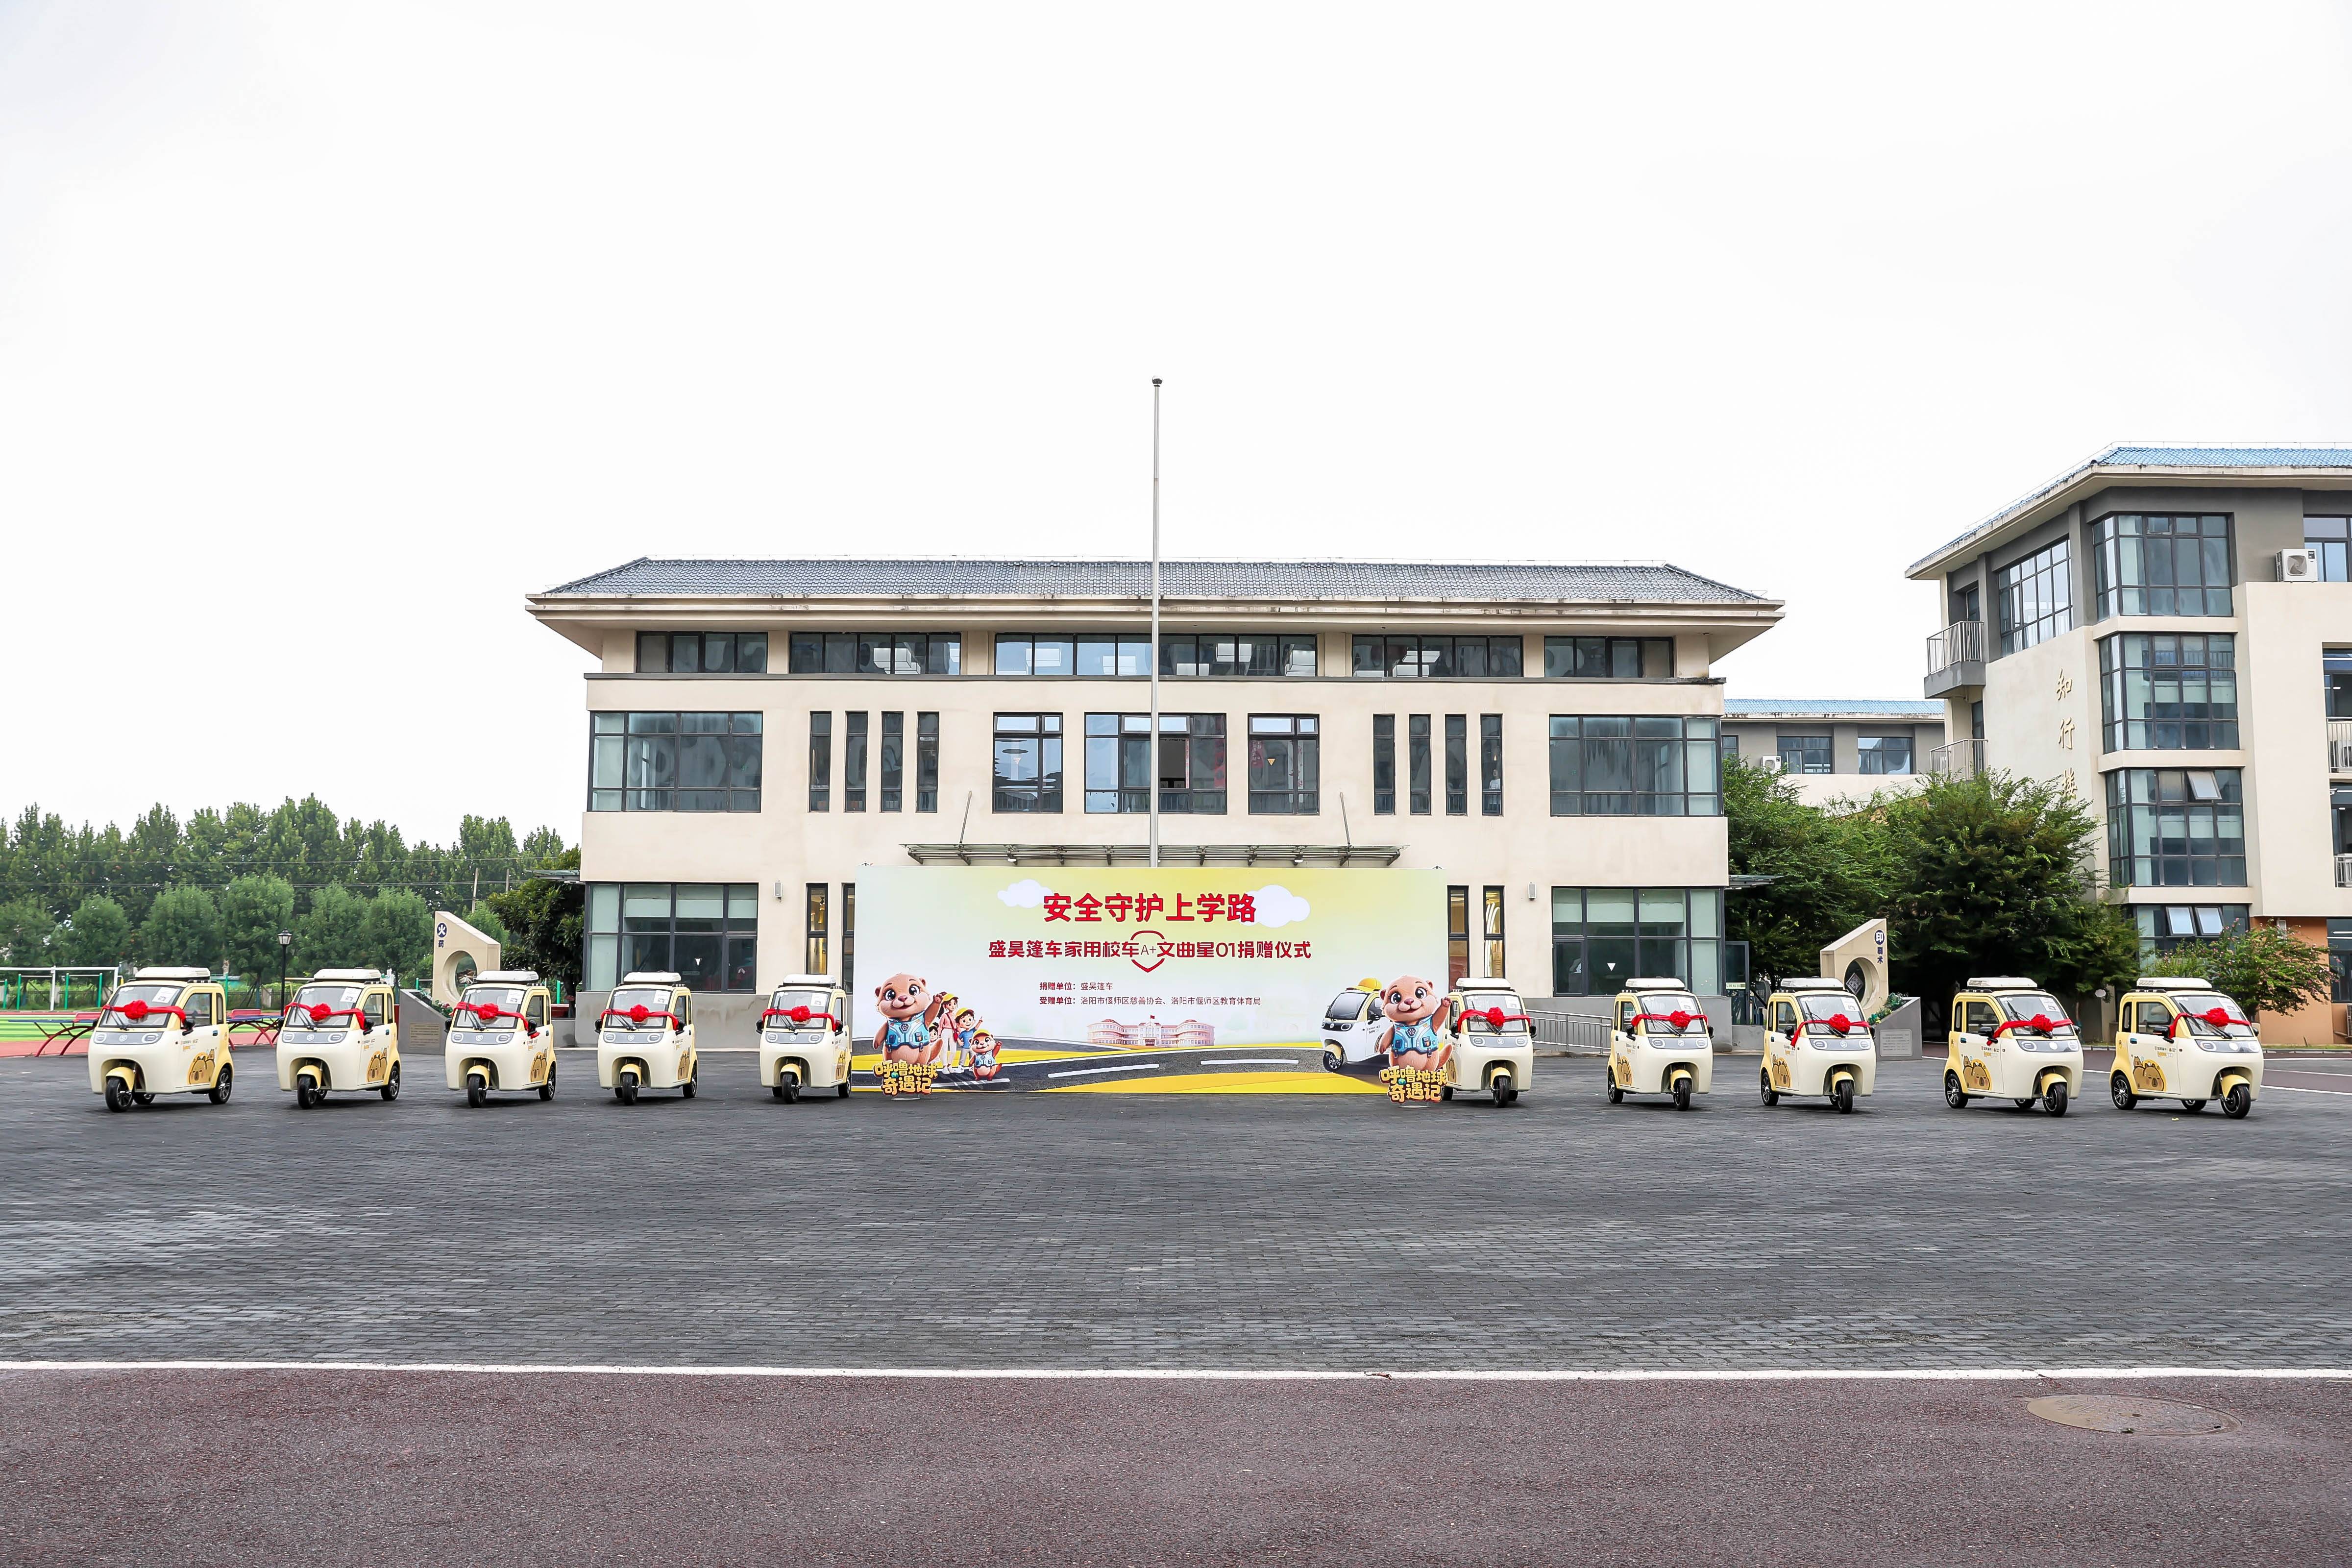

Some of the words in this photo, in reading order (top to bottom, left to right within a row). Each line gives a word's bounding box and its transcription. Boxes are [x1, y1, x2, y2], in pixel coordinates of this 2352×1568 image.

[1043, 893, 1257, 922] 安全守护上学路
[874, 1059, 938, 1078] 呼噜地球
[1380, 1065, 1447, 1085] 呼噜地球
[882, 1076, 931, 1095] 奇遇记
[1389, 1082, 1441, 1102] 奇遇记
